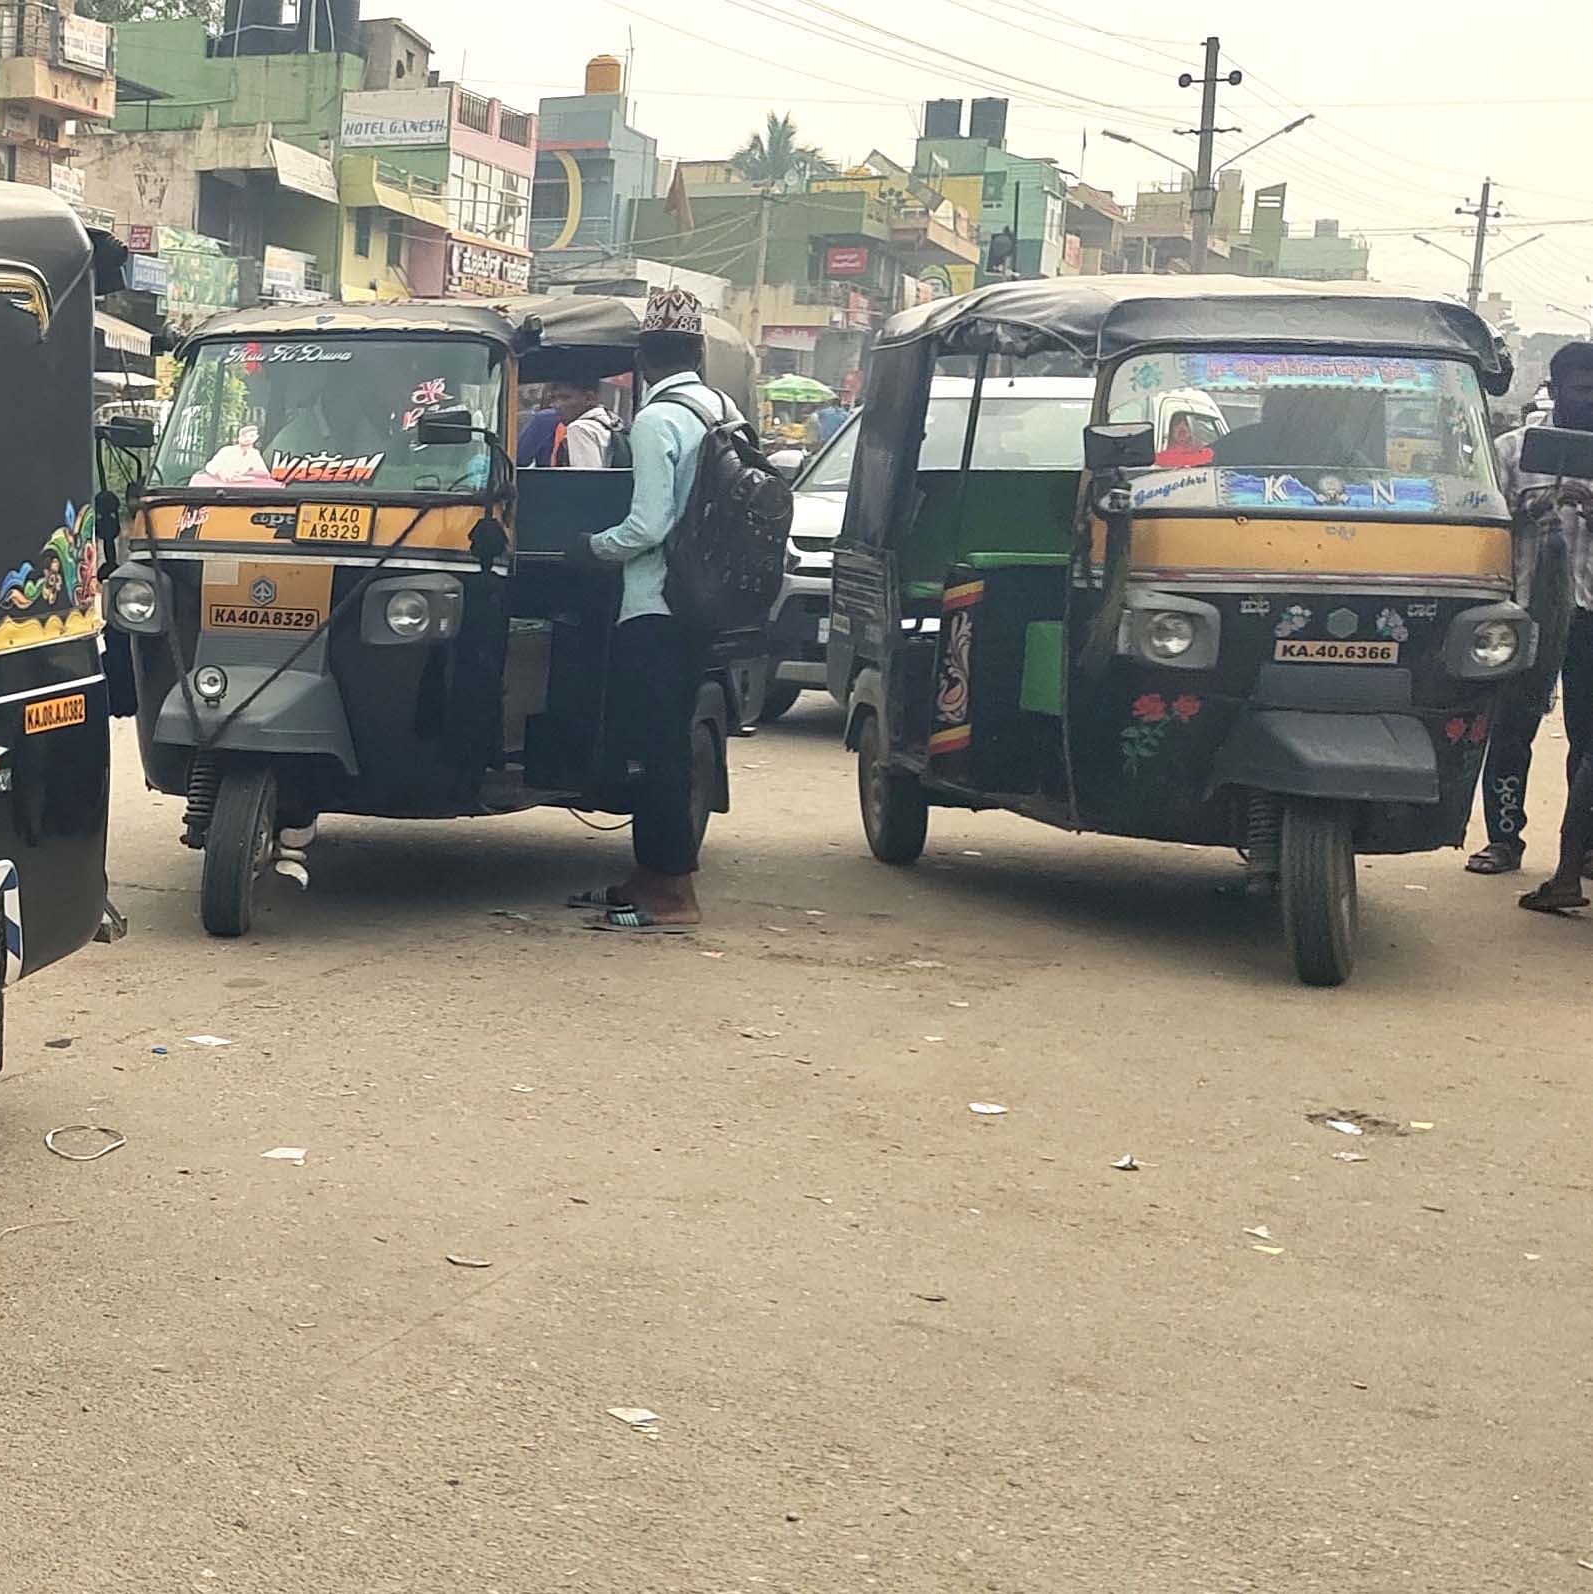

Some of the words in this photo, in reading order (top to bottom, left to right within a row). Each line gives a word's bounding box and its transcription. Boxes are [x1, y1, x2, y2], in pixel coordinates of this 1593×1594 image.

[344, 121, 386, 136] HOTEL
[271, 451, 385, 484] WASEEM
[1263, 476, 1290, 504] K
[1371, 478, 1397, 505] N
[318, 507, 360, 523] KA40
[309, 523, 361, 540] A8329
[214, 608, 316, 627] KA40A8329
[1281, 643, 1392, 660] KA.40.6366
[27, 698, 84, 730] KA.08.A.0382
